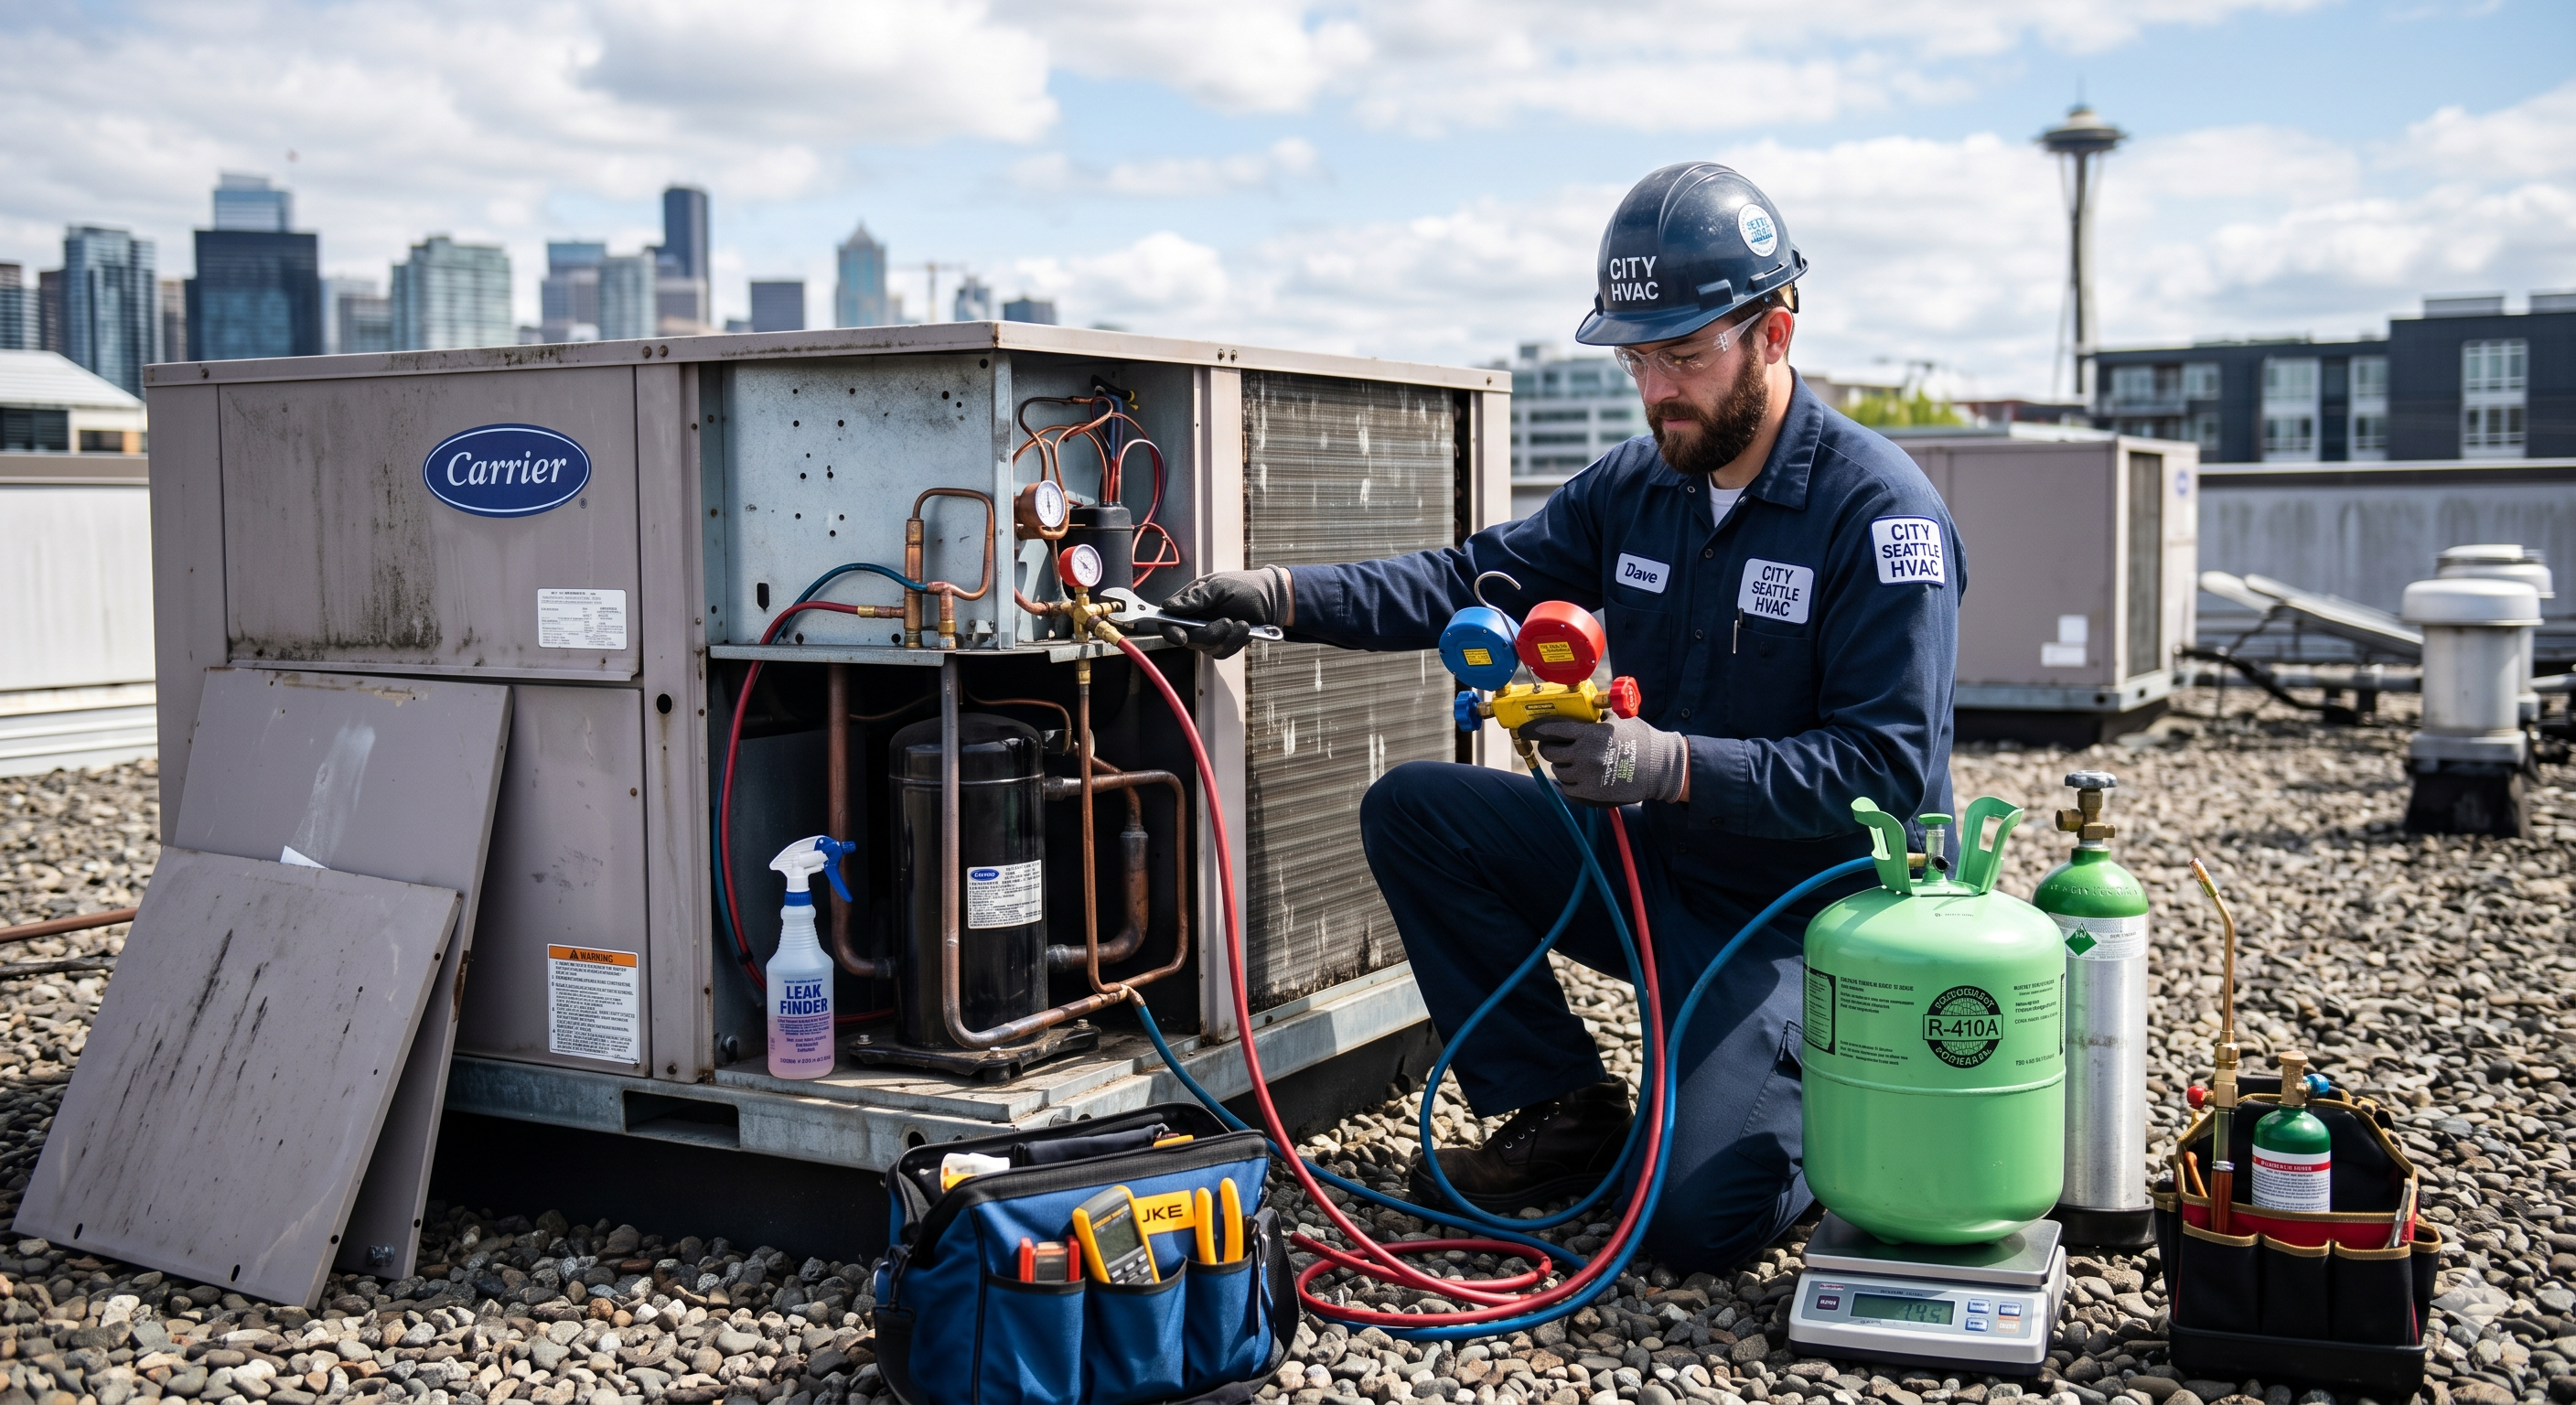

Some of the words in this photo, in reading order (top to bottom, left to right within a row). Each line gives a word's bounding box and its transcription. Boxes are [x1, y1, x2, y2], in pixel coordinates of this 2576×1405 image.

[1610, 256, 1657, 280] CITY
[1612, 282, 1658, 301] HVAC
[447, 451, 567, 486] Carrier
[1891, 524, 1930, 541] CITY
[1882, 542, 1940, 559] SEATTLE
[1625, 562, 1658, 584] Dave
[1762, 565, 1795, 585] CITY
[1891, 559, 1939, 578] HVAC
[1751, 582, 1800, 601] SEATTLE
[1755, 596, 1791, 617] HVAC
[580, 951, 614, 963] WARNING
[786, 984, 821, 999] LEAK
[780, 997, 828, 1015] FINDER
[1928, 1018, 1999, 1037] R-410A
